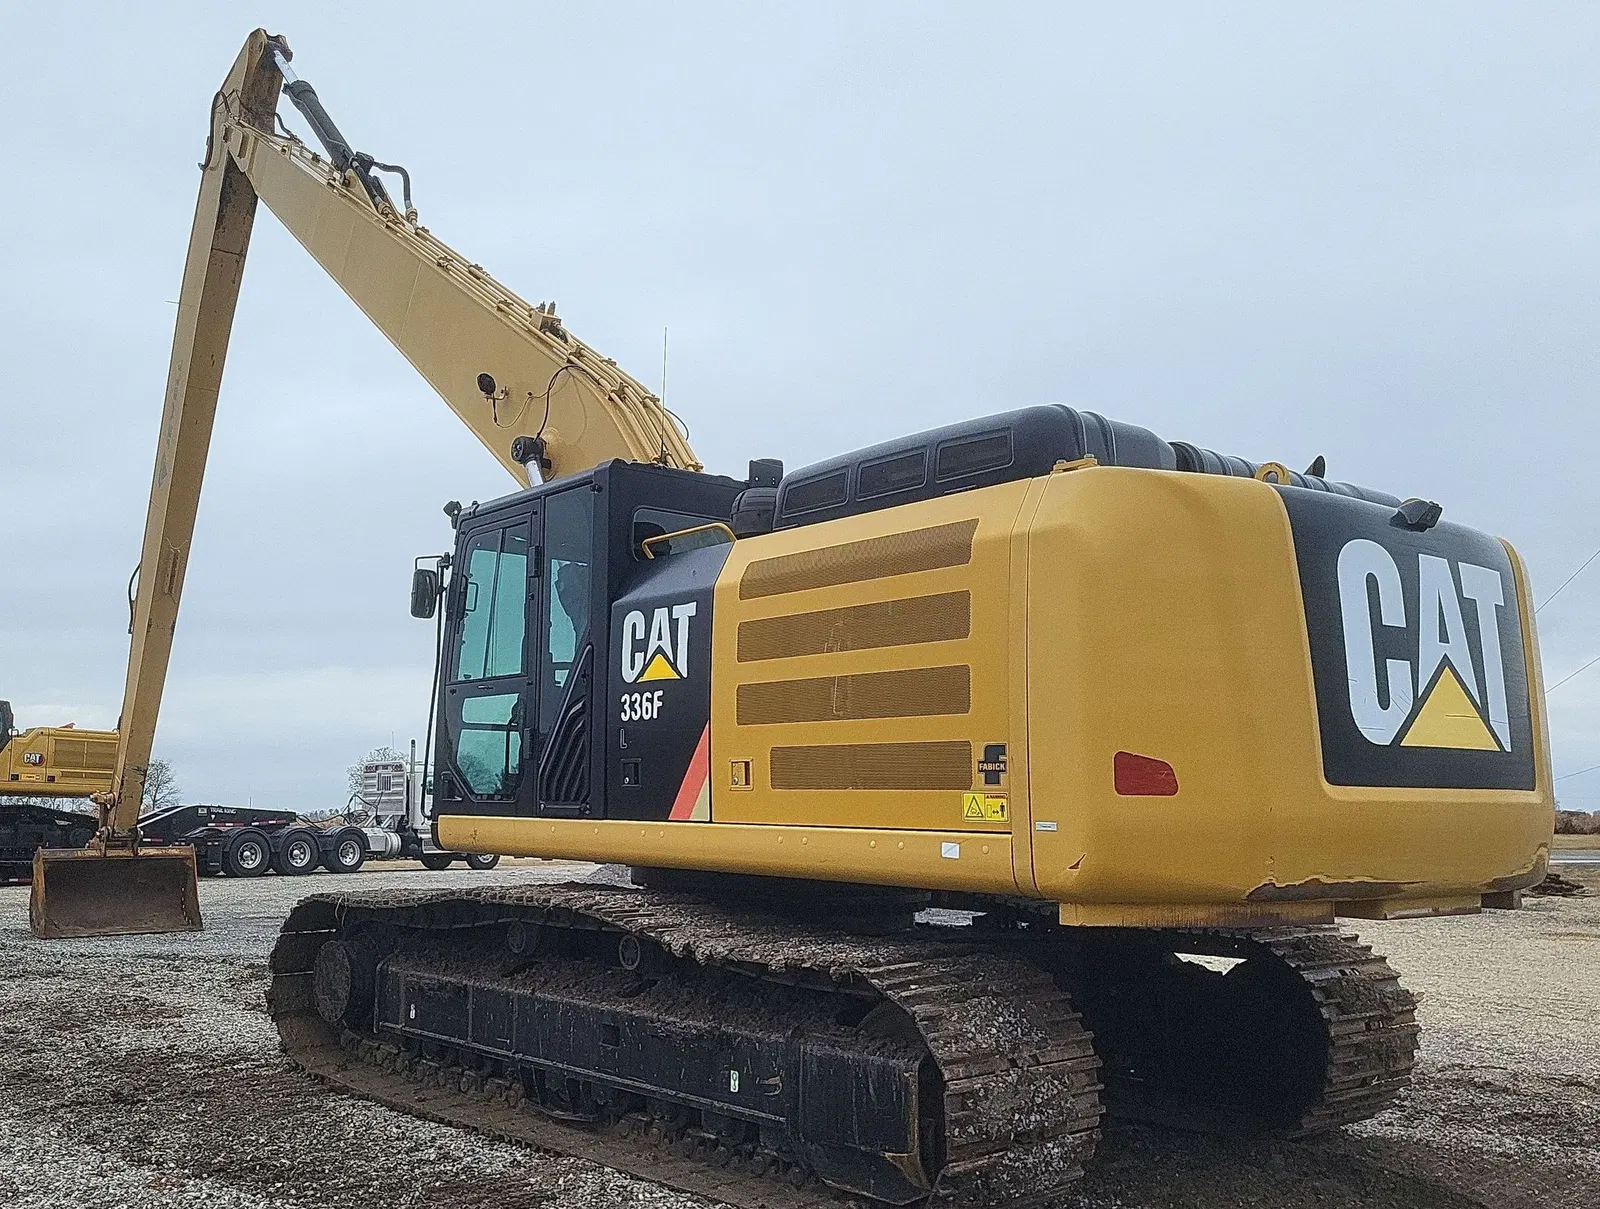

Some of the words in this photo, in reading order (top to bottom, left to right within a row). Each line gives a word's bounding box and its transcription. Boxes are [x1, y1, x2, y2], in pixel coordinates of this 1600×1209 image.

[621, 602, 697, 682] CAT
[1338, 539, 1512, 753] CAT
[620, 690, 663, 722] 336F
[24, 753, 41, 763] CAT
[979, 762, 1005, 771] FABICK
